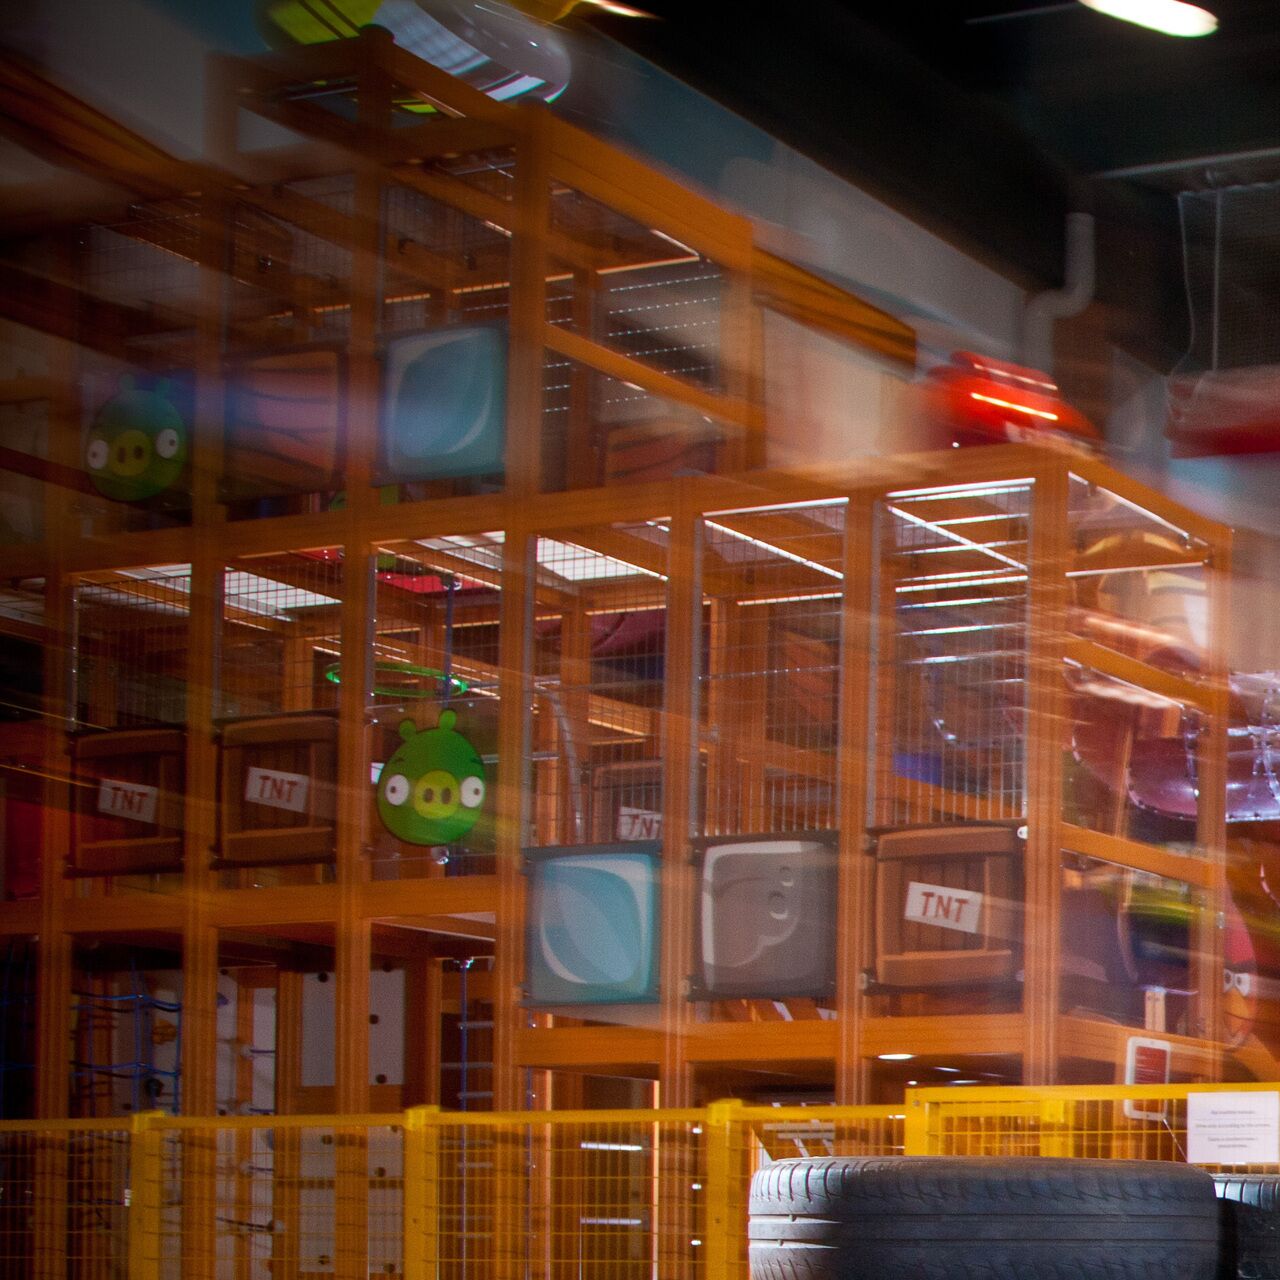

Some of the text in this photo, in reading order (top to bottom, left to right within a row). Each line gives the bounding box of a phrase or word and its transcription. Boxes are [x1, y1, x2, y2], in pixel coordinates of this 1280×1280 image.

[111, 787, 148, 814] TNT
[260, 775, 298, 802] TNT
[921, 892, 969, 922] TNT
